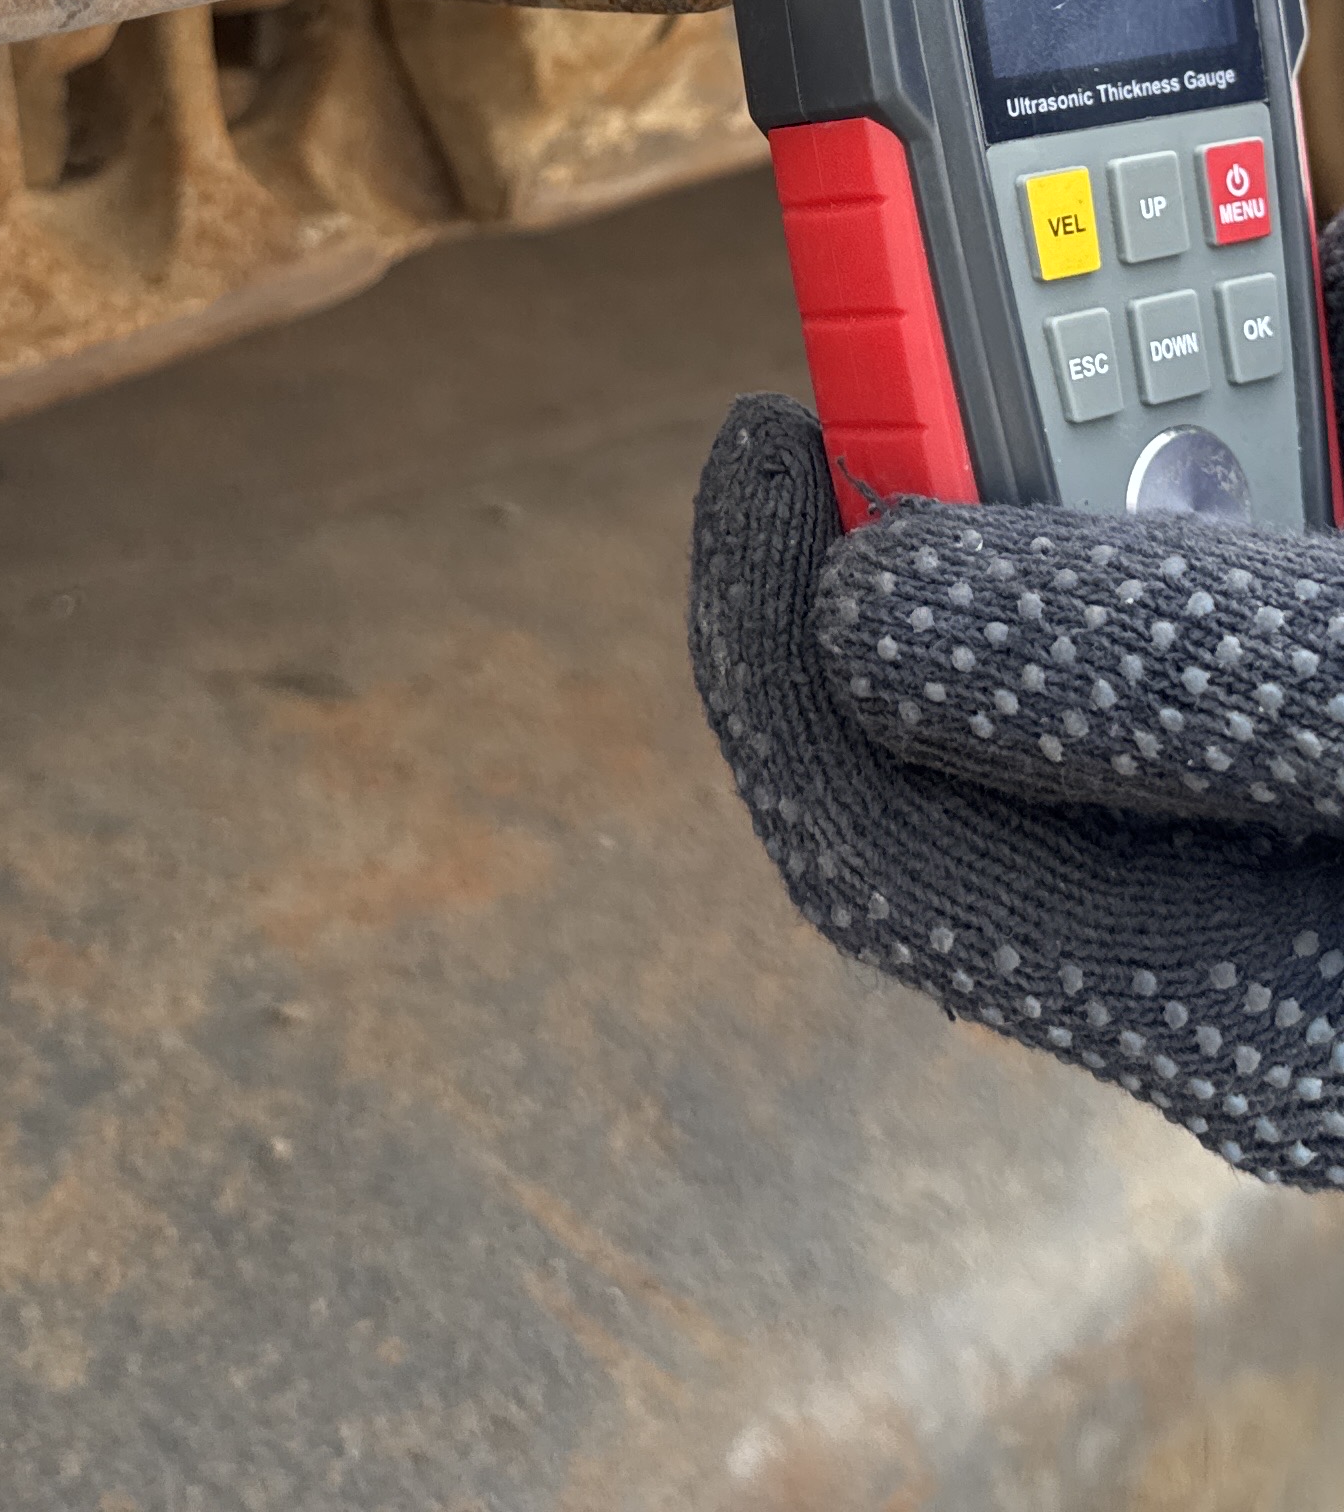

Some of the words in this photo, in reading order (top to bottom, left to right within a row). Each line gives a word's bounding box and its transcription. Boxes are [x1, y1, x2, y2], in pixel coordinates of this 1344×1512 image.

[1006, 89, 1094, 117] Ultrasonic
[1096, 78, 1181, 103] Thickness
[1184, 69, 1236, 90] Gauge
[1140, 196, 1167, 219] UP
[1219, 197, 1265, 224] MENU
[1048, 213, 1086, 237] VEL
[1243, 316, 1273, 341] OK
[1150, 333, 1199, 362] DOWN
[1069, 352, 1109, 381] ESC
